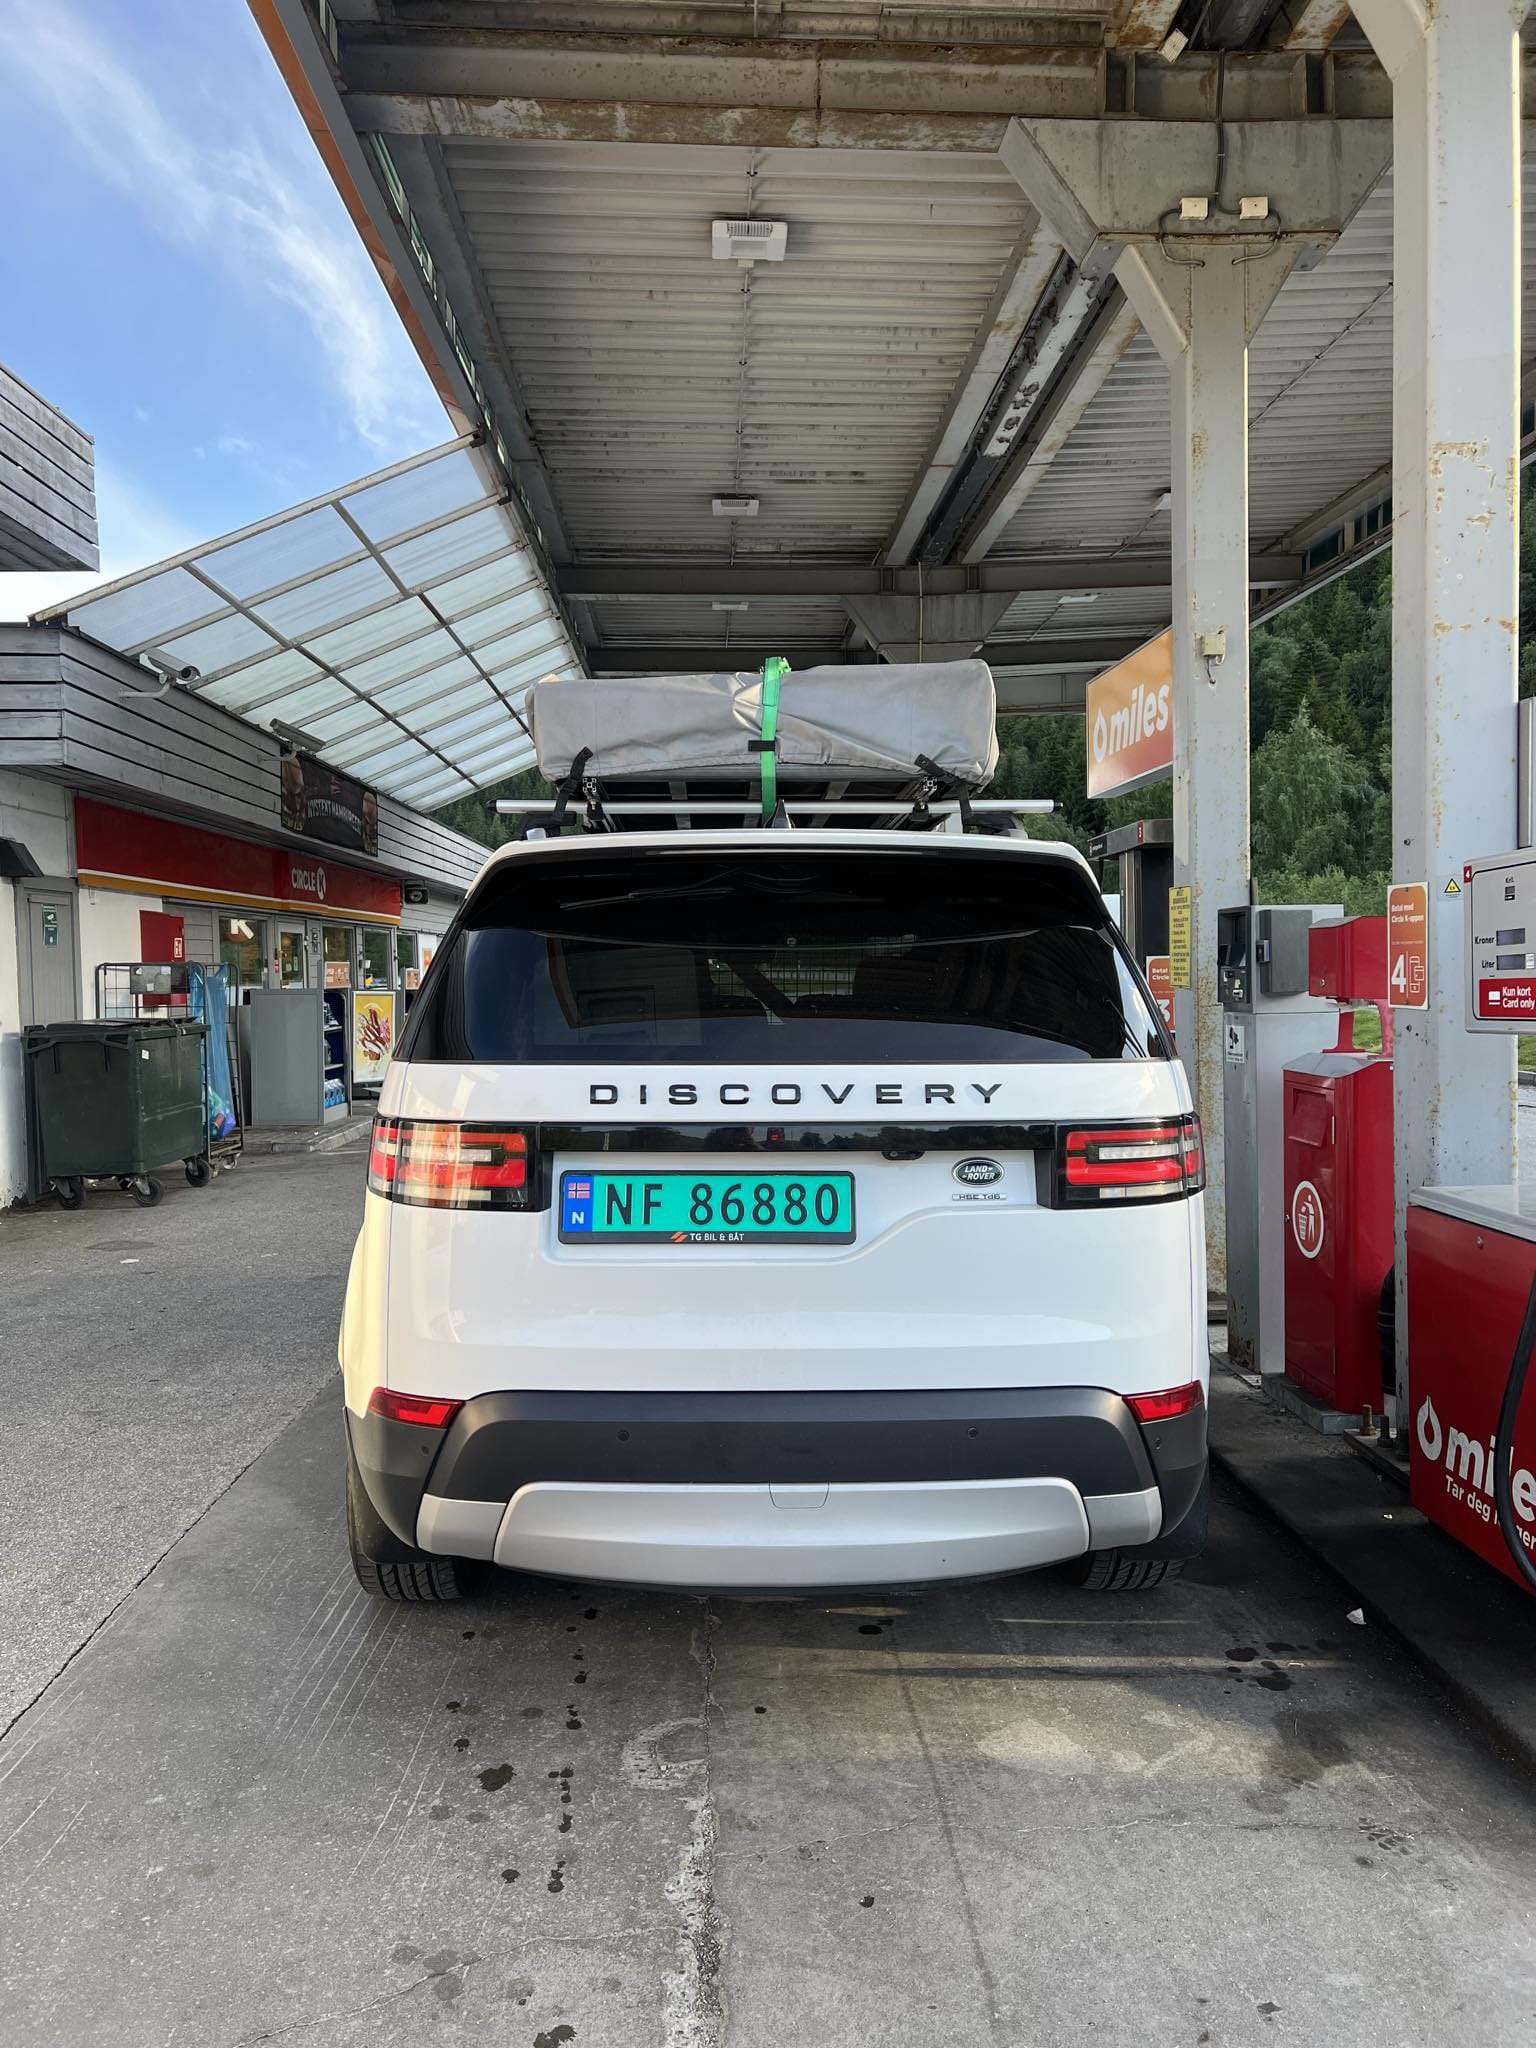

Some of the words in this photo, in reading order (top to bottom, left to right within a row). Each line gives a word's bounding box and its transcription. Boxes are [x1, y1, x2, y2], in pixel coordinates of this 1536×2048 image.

[1109, 684, 1169, 755] miles
[1465, 870, 1470, 879] 4
[292, 867, 315, 891] CIRCLE
[317, 867, 326, 900] K
[1392, 915, 1404, 923] Circle
[1475, 936, 1494, 944] Kroner
[1482, 960, 1495, 969] Liter
[1391, 954, 1406, 993] 4
[1502, 987, 1515, 997] Kun
[1517, 986, 1531, 997] kort
[1157, 999, 1170, 1023] 3
[1502, 997, 1520, 1008] Card
[1520, 997, 1535, 1010] only
[589, 1083, 1003, 1105] DISCOVERY
[606, 1183, 663, 1225] NF
[689, 1183, 839, 1226] 86880
[572, 1212, 584, 1224] N
[690, 1233, 702, 1241] TG
[704, 1233, 717, 1241] BIL
[719, 1233, 726, 1241] &
[728, 1232, 744, 1241] BÅT
[1445, 1427, 1536, 1523] mie
[1445, 1475, 1464, 1501] Tar
[1467, 1491, 1491, 1522] deg
